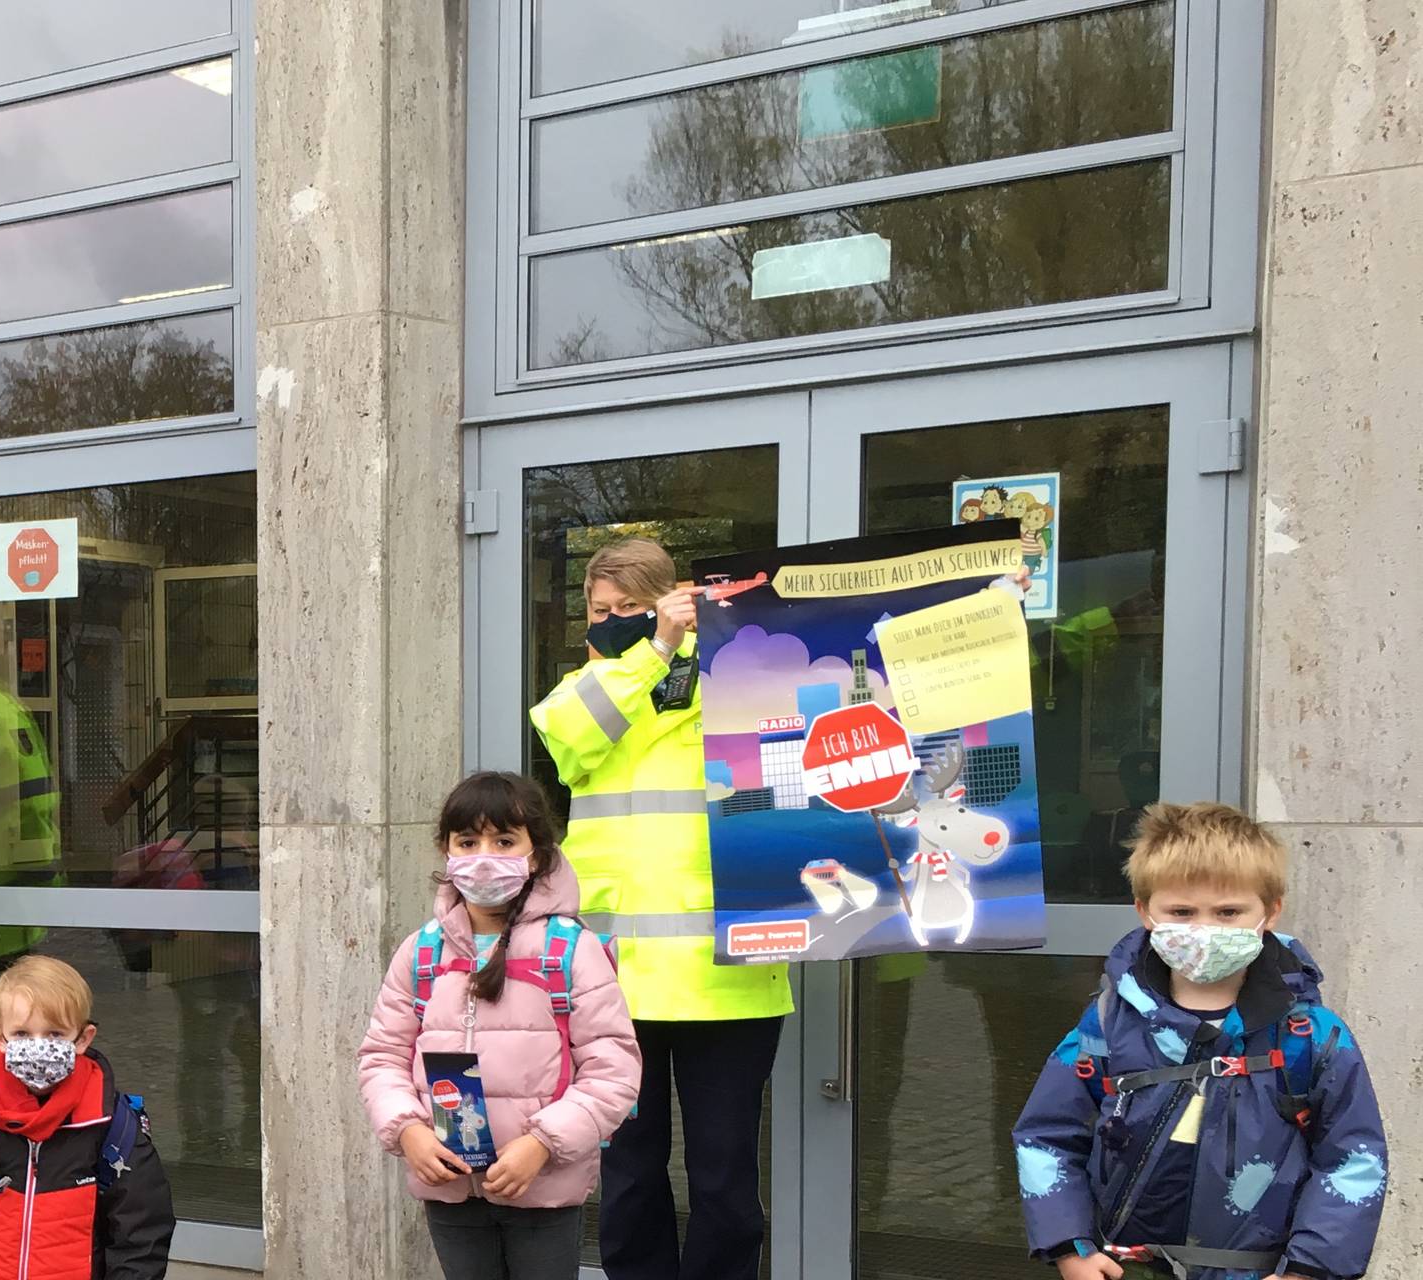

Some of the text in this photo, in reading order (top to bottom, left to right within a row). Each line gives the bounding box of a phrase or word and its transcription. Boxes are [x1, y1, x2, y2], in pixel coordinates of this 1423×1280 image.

[784, 547, 1018, 593] MEHR SICHERHEIT AUF DEM SCHULWEG
[915, 623, 932, 637] MAN
[934, 618, 952, 633] DICH
[953, 614, 964, 628] IM
[760, 717, 804, 731] RADIO
[821, 723, 880, 759] ICH BIN
[801, 744, 921, 797] EMIL
